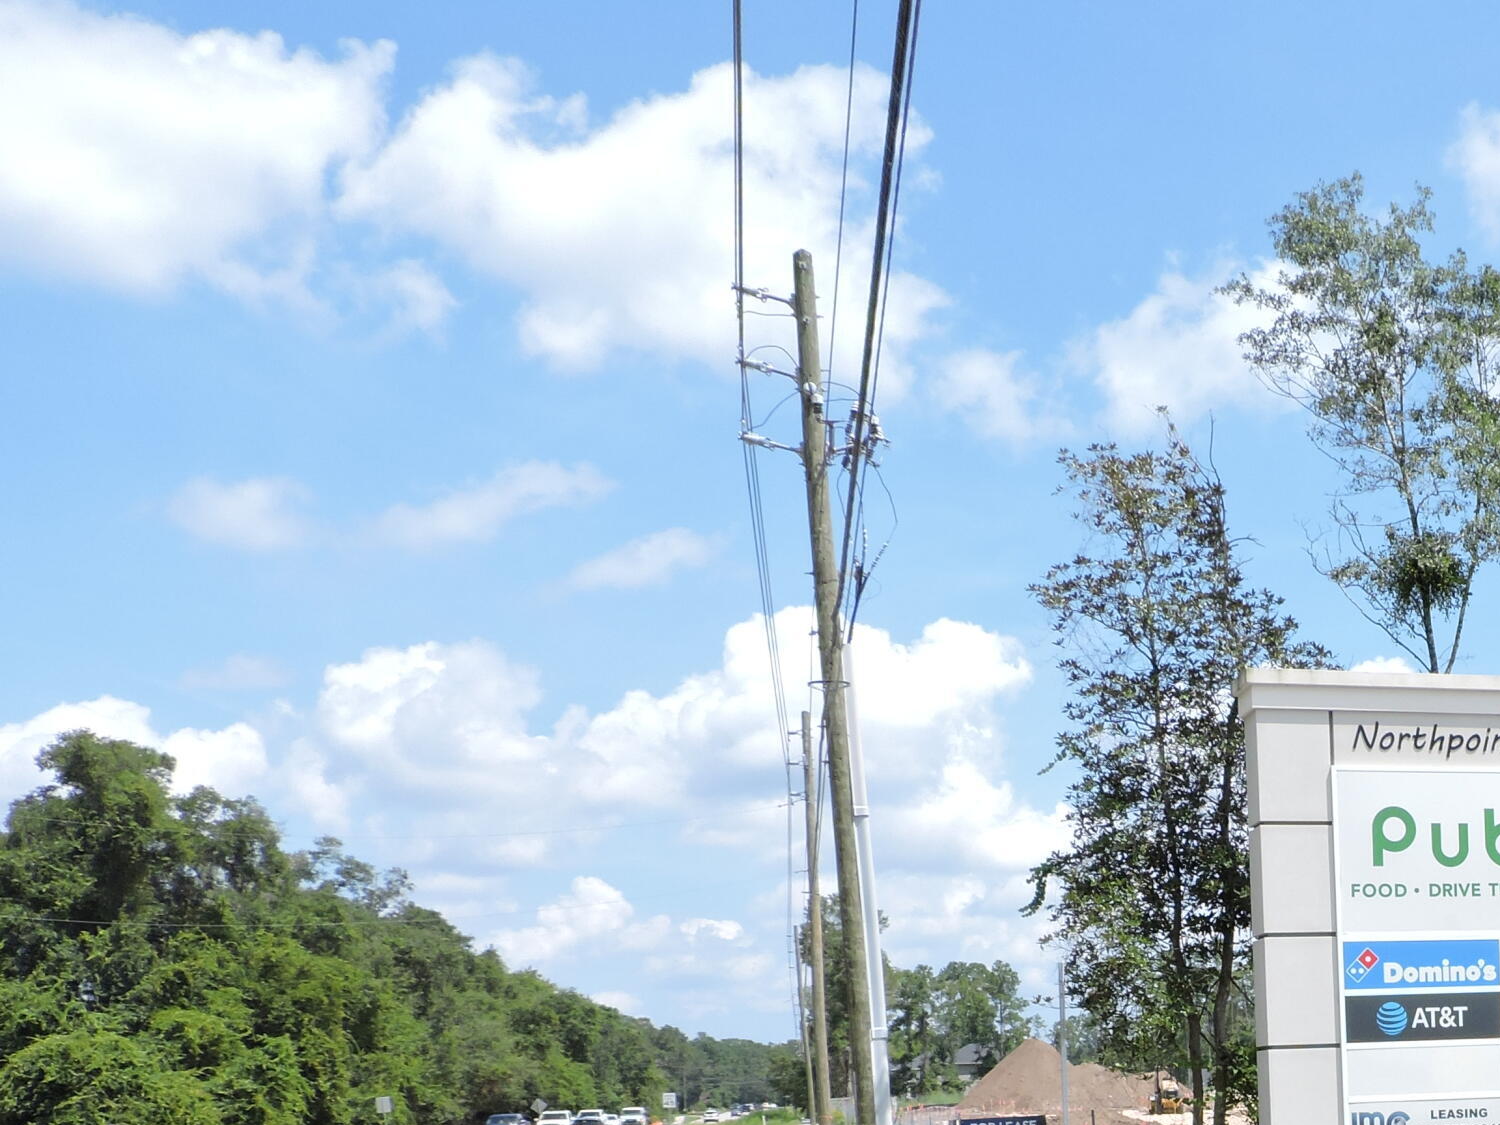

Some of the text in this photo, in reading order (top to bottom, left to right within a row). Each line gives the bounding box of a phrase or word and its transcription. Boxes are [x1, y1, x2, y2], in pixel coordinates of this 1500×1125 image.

[1351, 883, 1408, 898] FOOD
[1428, 883, 1482, 897] DRIVE
[1383, 959, 1497, 983] Domino's
[1411, 1006, 1468, 1028] AT&T
[1430, 1108, 1488, 1119] LEASING
